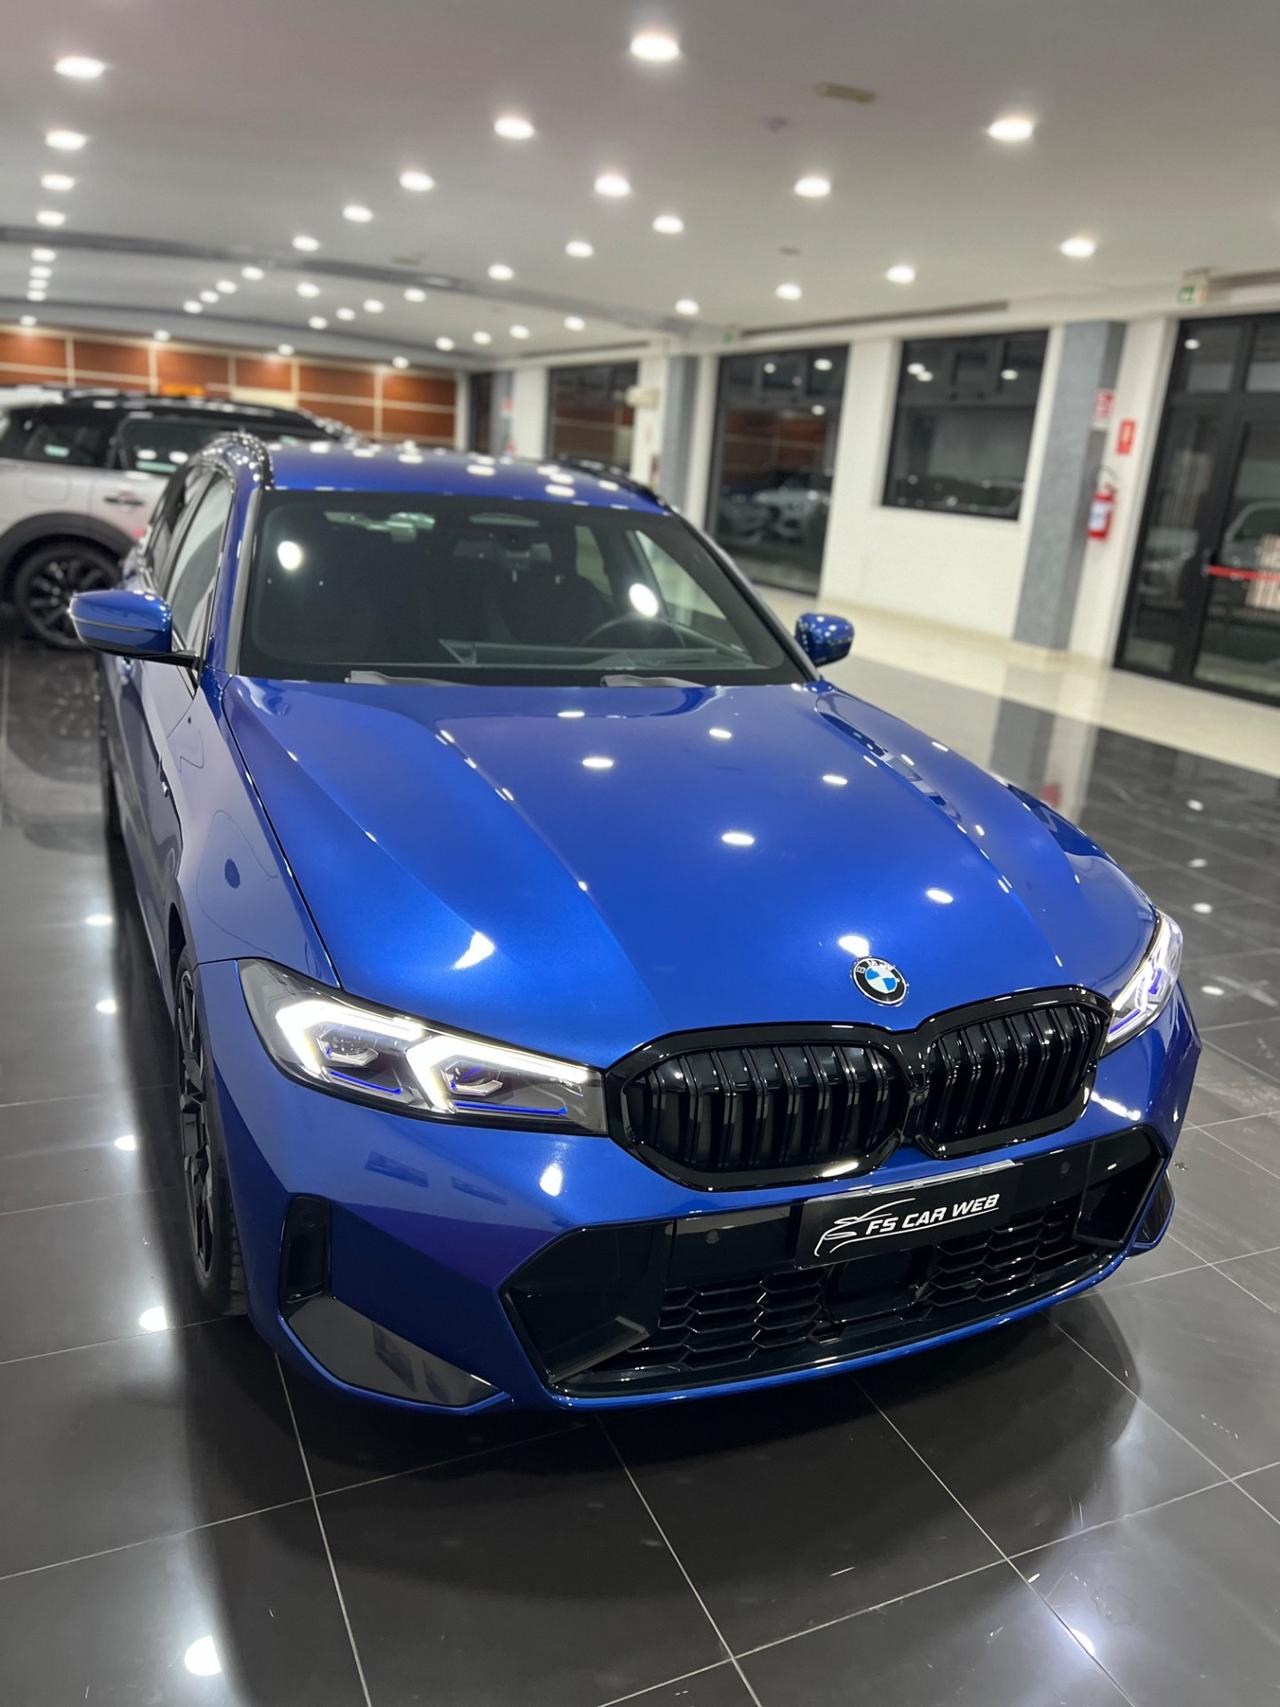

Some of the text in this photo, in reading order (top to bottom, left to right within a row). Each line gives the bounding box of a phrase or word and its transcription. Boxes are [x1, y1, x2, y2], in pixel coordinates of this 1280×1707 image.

[866, 1193, 1000, 1236] FS CAR WEB
